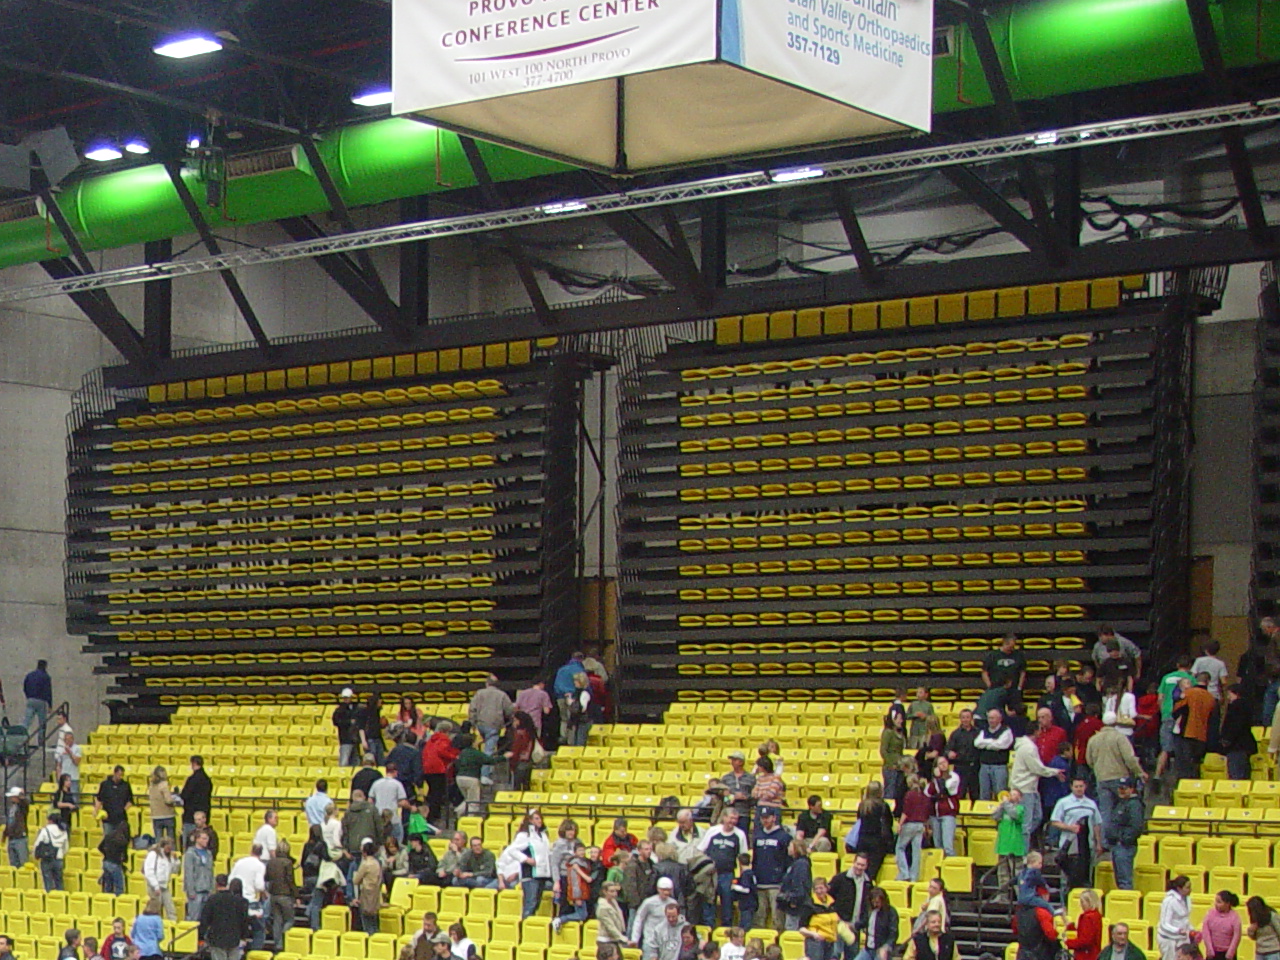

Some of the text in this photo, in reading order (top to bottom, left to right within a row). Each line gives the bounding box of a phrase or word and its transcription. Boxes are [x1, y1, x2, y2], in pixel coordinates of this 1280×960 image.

[441, 0, 660, 48] CONFERENCE CENTER
[787, 11, 904, 68] and Sports Medicine
[788, 0, 931, 57] tah Valley Orthopaedics
[524, 61, 544, 75] 100
[546, 55, 588, 71] NORTH
[592, 48, 631, 63] PROVO
[787, 32, 841, 65] 357-7129
